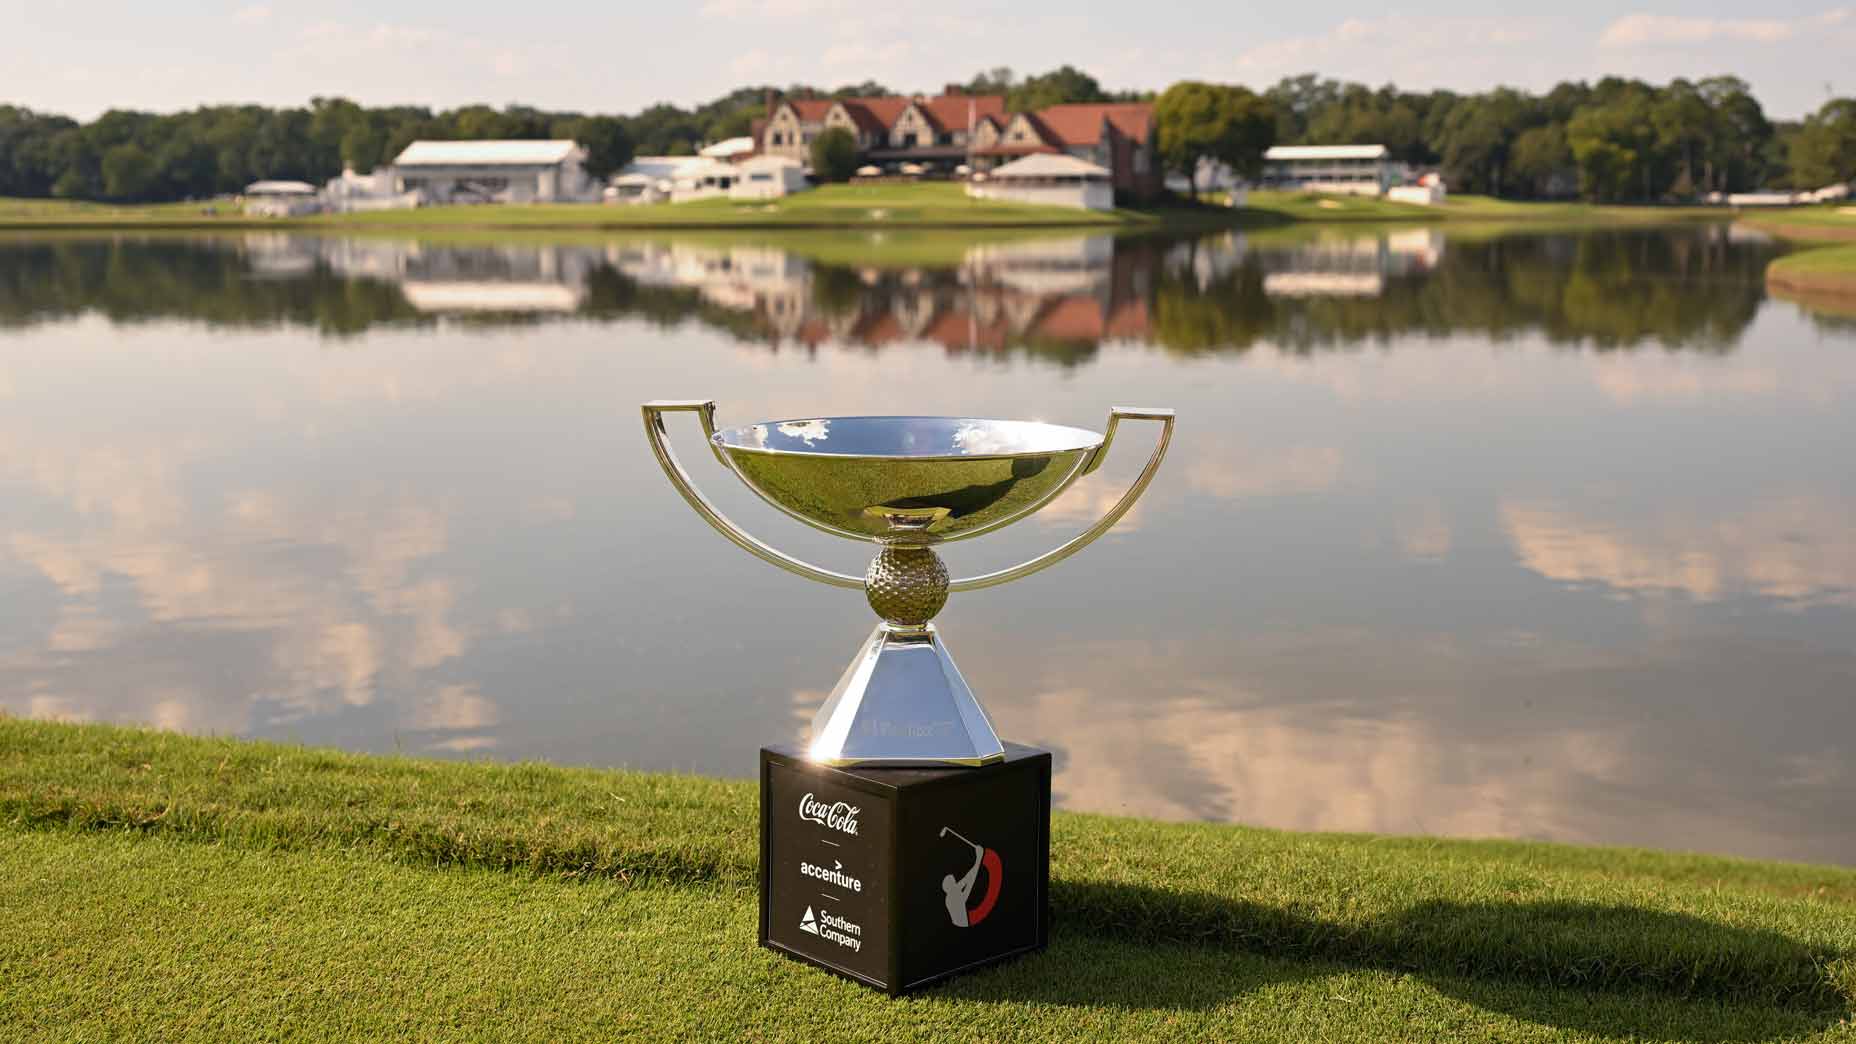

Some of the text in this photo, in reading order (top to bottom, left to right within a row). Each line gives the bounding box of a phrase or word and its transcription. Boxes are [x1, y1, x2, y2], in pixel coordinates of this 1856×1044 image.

[800, 860, 861, 892] accenture
[820, 910, 861, 936] Southern
[819, 926, 861, 952] Company
